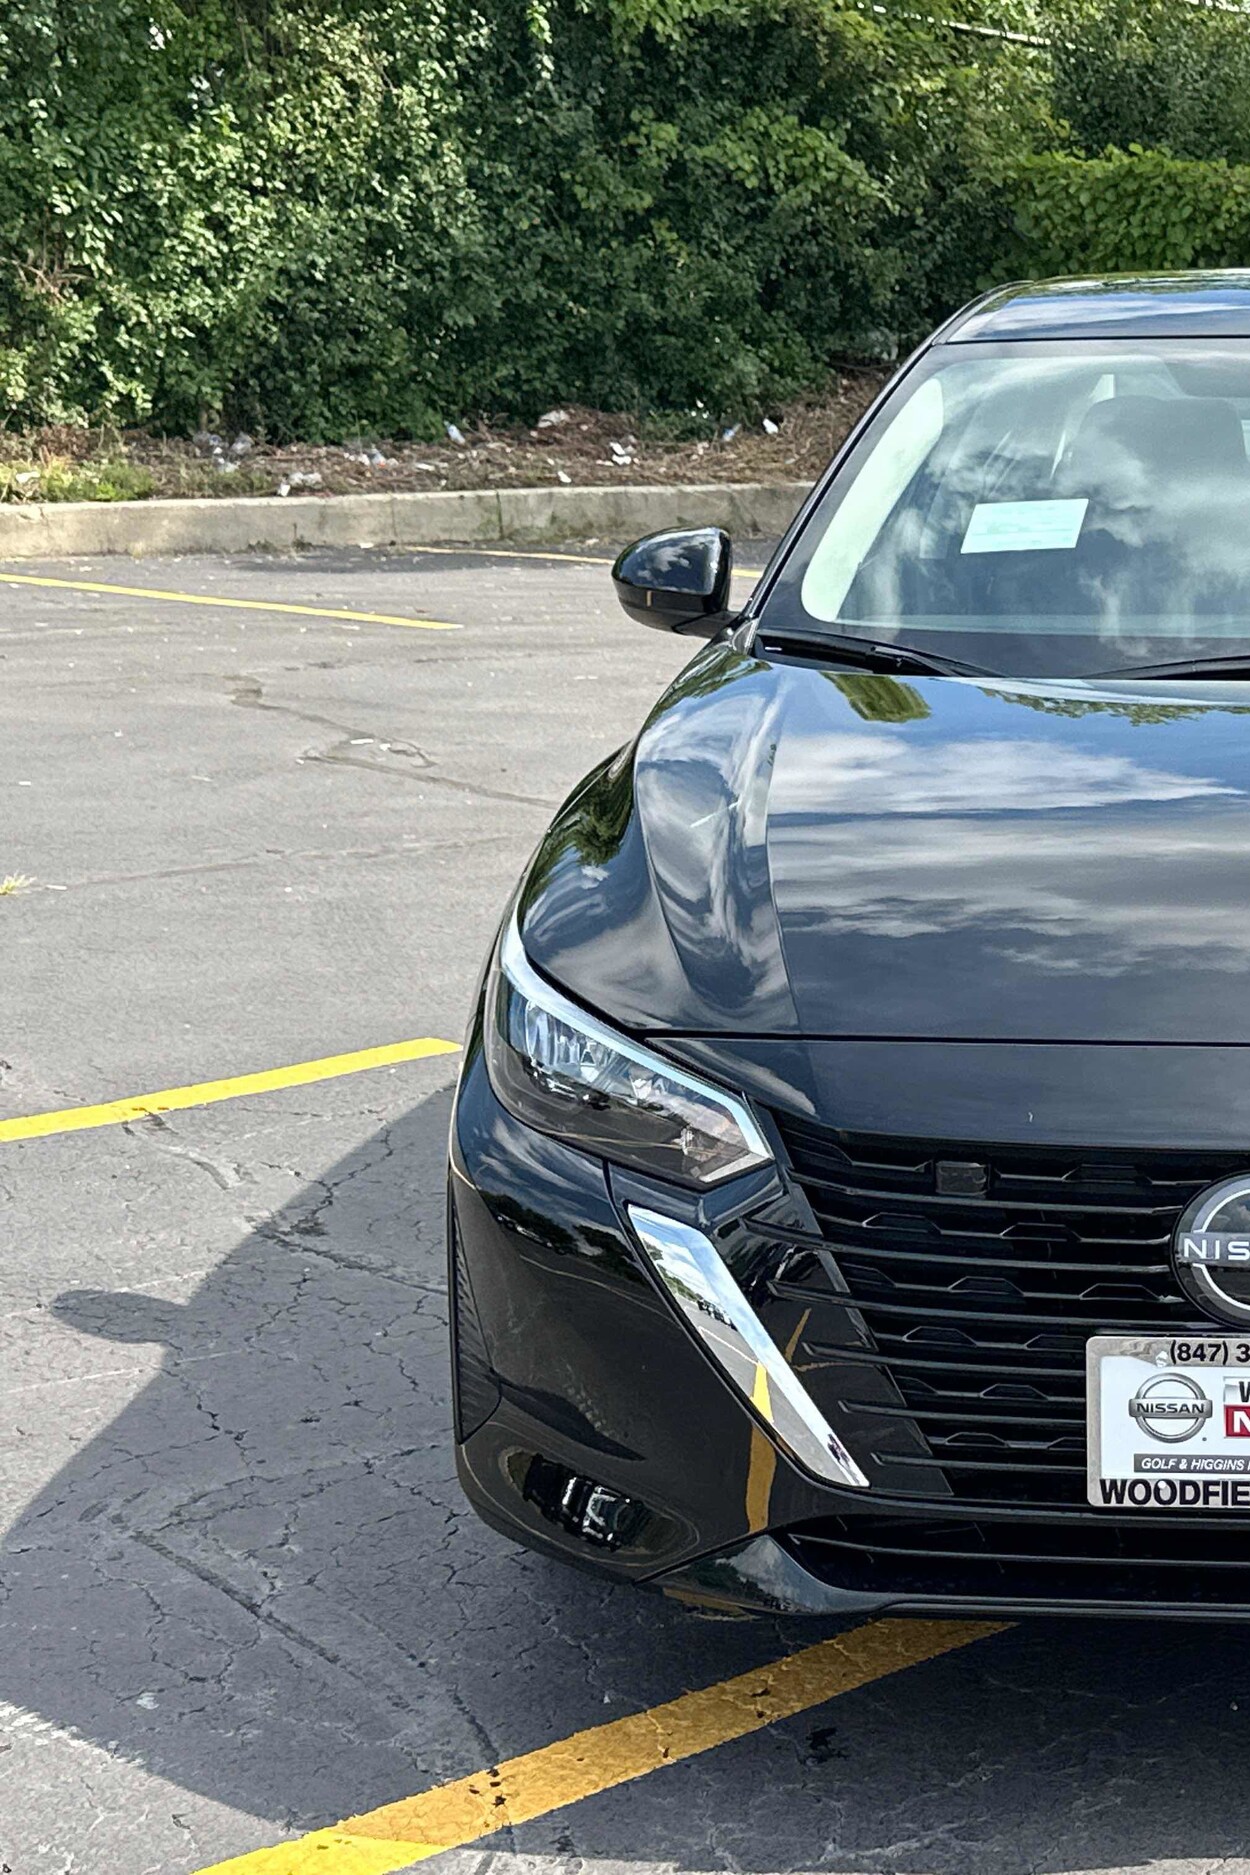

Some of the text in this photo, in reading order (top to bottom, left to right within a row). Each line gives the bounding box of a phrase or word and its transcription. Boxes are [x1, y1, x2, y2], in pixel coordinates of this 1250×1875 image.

[1170, 1340, 1228, 1366] (847)
[1136, 1402, 1205, 1415] NISSAN
[1141, 1458, 1177, 1470] GOLF
[1179, 1458, 1188, 1470] &
[1190, 1459, 1245, 1472] HIGGINS
